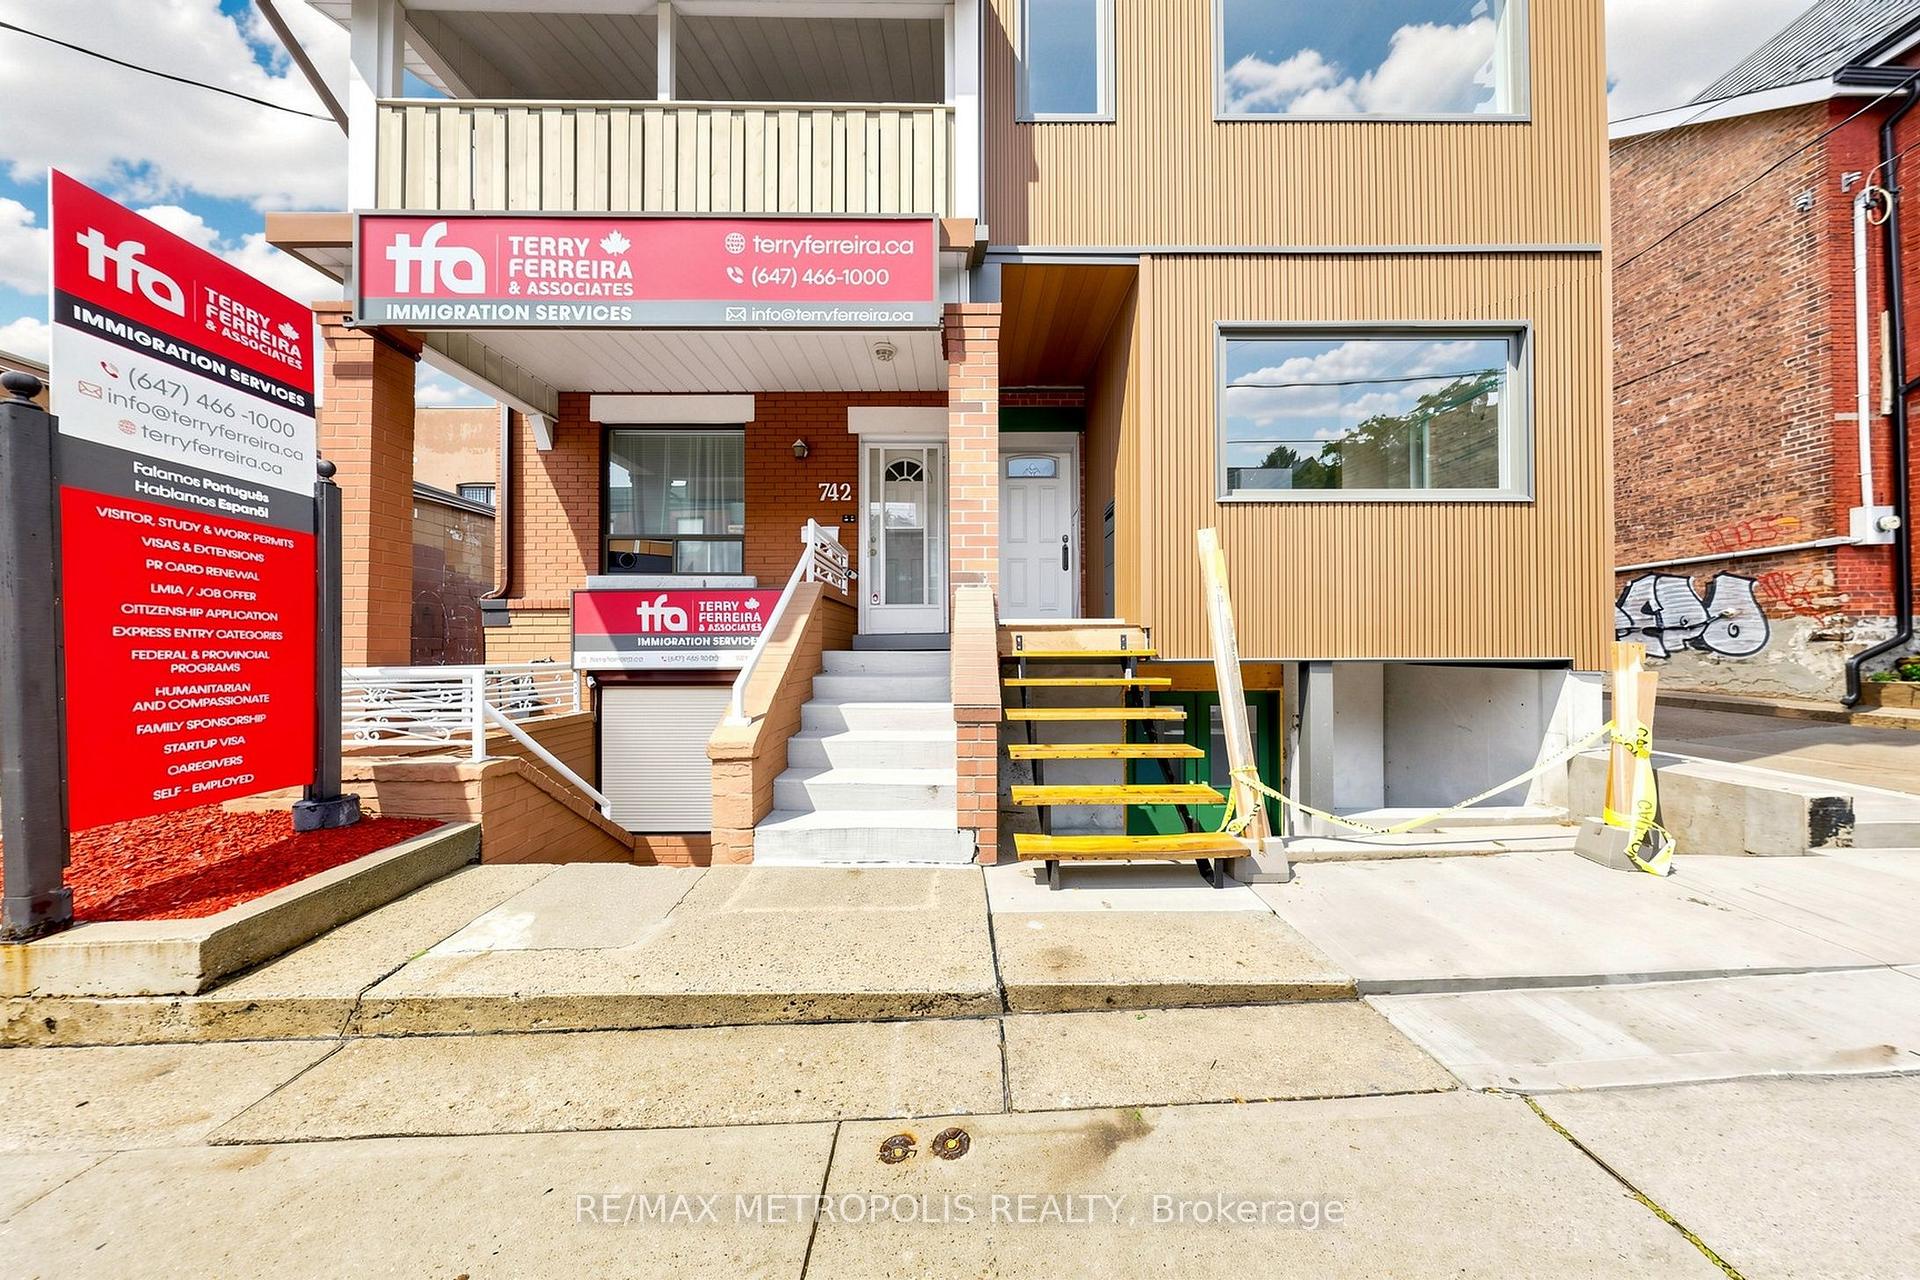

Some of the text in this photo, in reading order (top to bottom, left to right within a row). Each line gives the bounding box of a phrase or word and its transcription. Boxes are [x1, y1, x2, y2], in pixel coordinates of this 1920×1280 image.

[508, 236, 590, 256] TERRY
[752, 234, 914, 258] terryferreira.ca
[386, 222, 486, 294] tfa
[76, 226, 185, 318] tfa
[509, 259, 632, 278] FERREIRA
[751, 266, 889, 288] (647) 466-1000
[508, 282, 633, 296] & ASSOCIATES
[205, 286, 271, 328] TERRY
[386, 304, 632, 320] IMMIGRATION SERVICES
[751, 308, 913, 322] info@terryferreira.ca
[206, 304, 303, 359] FERREIRA
[73, 305, 306, 407] IMMIGRATION SERVICES
[205, 321, 303, 371] & ASSOCIATES
[129, 367, 189, 406] (647)
[196, 394, 236, 418] 466
[107, 388, 304, 461] info@terryferreira.ca
[141, 423, 283, 475] terryferreira.ca
[133, 461, 269, 503] Falamos Português
[818, 483, 852, 501] 742
[135, 480, 216, 507] Hablamos
[158, 515, 202, 533] STUDY
[204, 524, 212, 535] &
[214, 527, 251, 541] WORK
[253, 534, 295, 549] PERMITS
[142, 537, 264, 563] VISAS & EXTENSIONS
[146, 559, 260, 581] PR CARD RENEWAL
[151, 584, 257, 601] LMIA / JOB OFFER
[121, 604, 278, 622] CITIZENSHIP APPLICATION
[637, 594, 688, 632] tfa
[698, 601, 739, 611] TERRY
[699, 613, 762, 623] FERREIRA
[708, 623, 762, 632] ASSOCIATES
[113, 627, 283, 640] EXPRESS ENTRY CATEGORIES
[637, 637, 758, 646] IMMIGRATION SERVICE
[131, 650, 270, 660] FEDERAL & PROVINCIAL
[171, 663, 240, 673] PROGRAMS
[156, 683, 251, 696] HUMANITARIAN
[132, 694, 270, 712] AND COMPASSIONATE
[136, 714, 266, 734] FAMILY SPONSORSHIP
[163, 736, 245, 754] STARTUP VISA
[168, 756, 243, 775] CAREGIVERS
[153, 786, 181, 800] SELF
[191, 774, 254, 794] EMPLOYED
